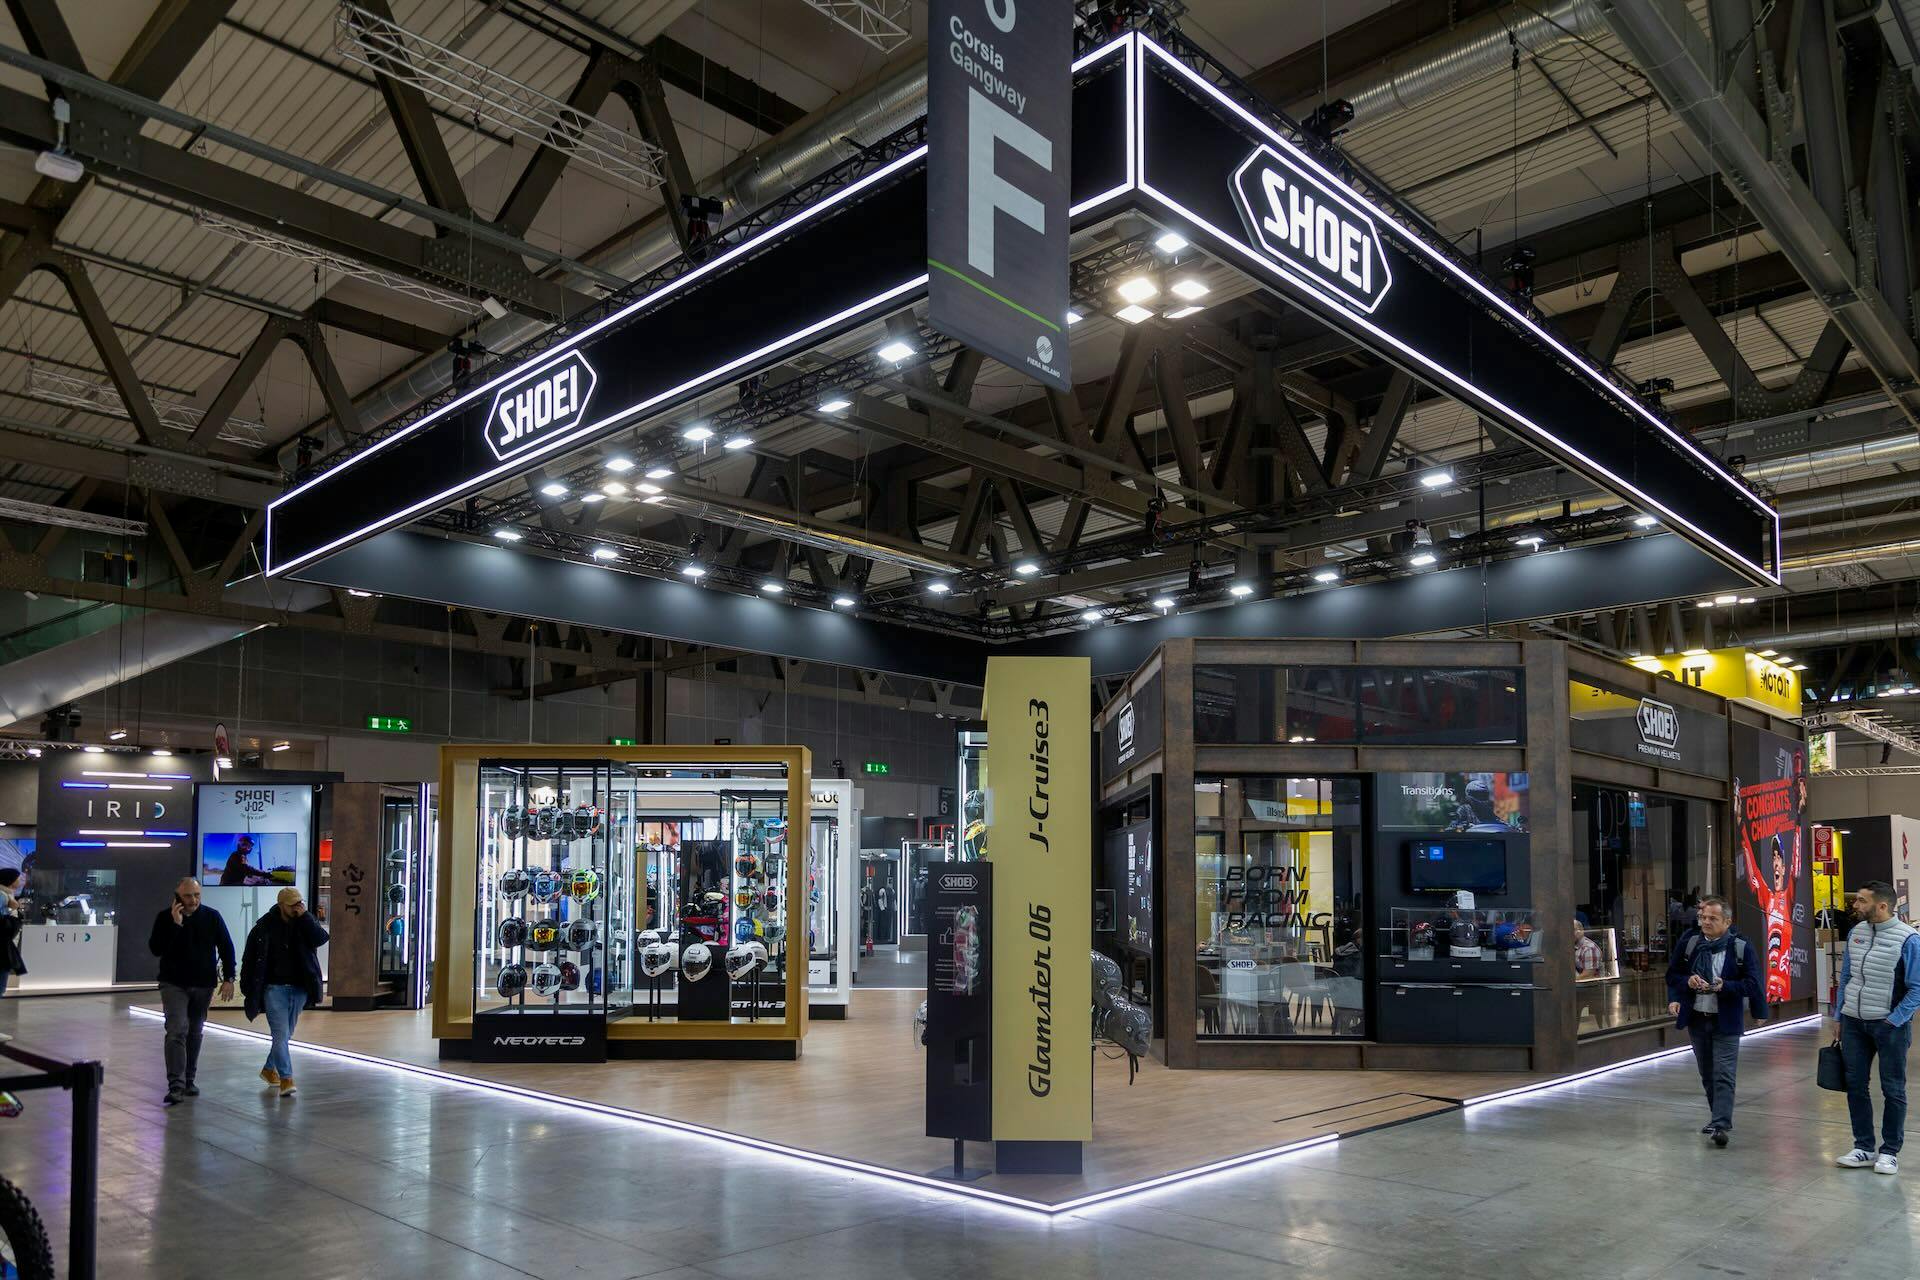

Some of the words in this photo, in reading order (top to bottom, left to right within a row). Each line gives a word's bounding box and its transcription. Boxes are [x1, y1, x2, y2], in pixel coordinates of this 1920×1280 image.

[950, 15, 1004, 73] Corsia
[950, 41, 1026, 114] Gangway
[968, 86, 1052, 278] F
[1262, 167, 1371, 294] SHOEI
[499, 365, 578, 446] SHOEI
[1643, 706, 1674, 740] SHOEI
[1638, 743, 1660, 756] PREMIUM
[1661, 749, 1681, 761] HELMETS
[1029, 698, 1049, 853] J-Cruise3
[235, 790, 274, 806] SHOEI
[1401, 784, 1454, 799] Transitions
[940, 801, 948, 815] 6
[944, 876, 973, 888] SHOEI
[1226, 866, 1307, 882] BORN
[1226, 889, 1309, 905] FROM
[1029, 902, 1050, 941] 06
[1226, 912, 1332, 929] RACING
[1231, 961, 1254, 969] SHOEI
[1029, 946, 1050, 1098] Glamster
[494, 1036, 585, 1046] NEOTEC3
